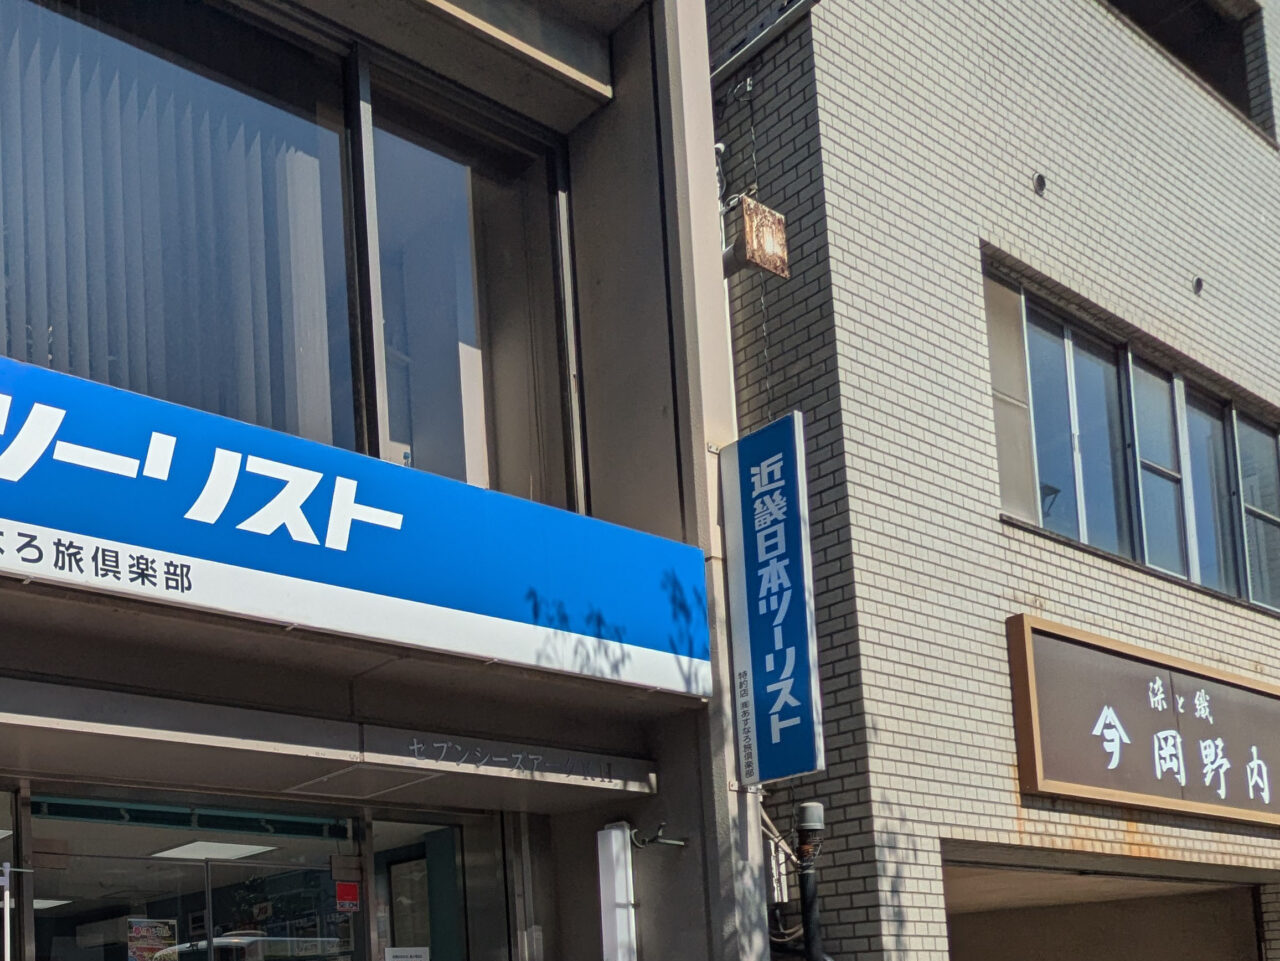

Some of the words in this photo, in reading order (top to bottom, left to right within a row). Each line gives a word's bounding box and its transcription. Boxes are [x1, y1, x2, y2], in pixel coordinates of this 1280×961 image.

[750, 452, 802, 745] 近畿日本ツーリスト
